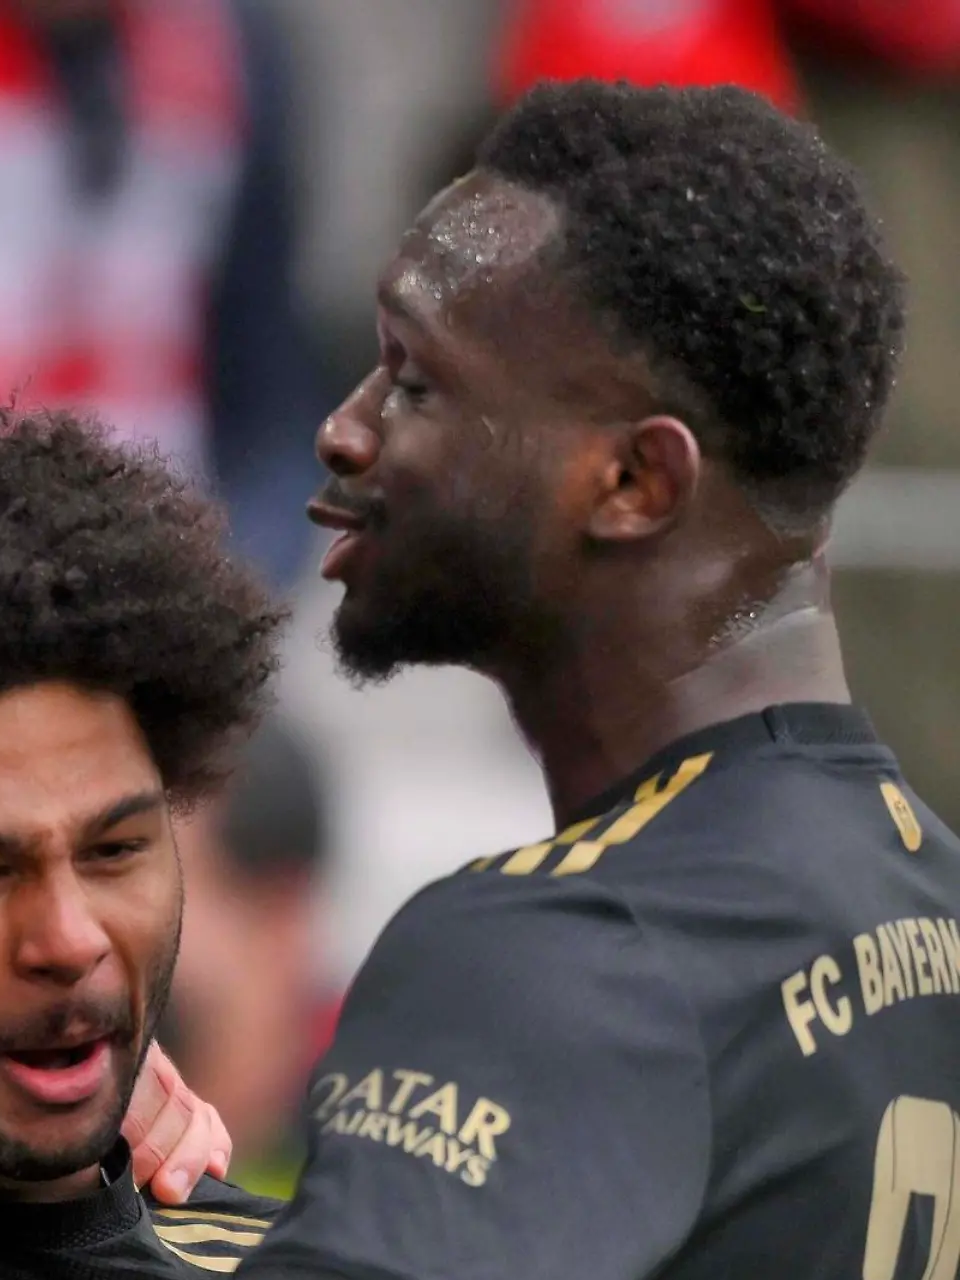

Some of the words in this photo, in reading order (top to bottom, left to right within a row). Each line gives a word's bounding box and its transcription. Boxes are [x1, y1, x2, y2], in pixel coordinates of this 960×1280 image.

[781, 970, 852, 1057] FC
[853, 917, 960, 1016] BAYERN
[311, 1068, 511, 1162] QATAR
[321, 1109, 491, 1187] AIRWAYS
